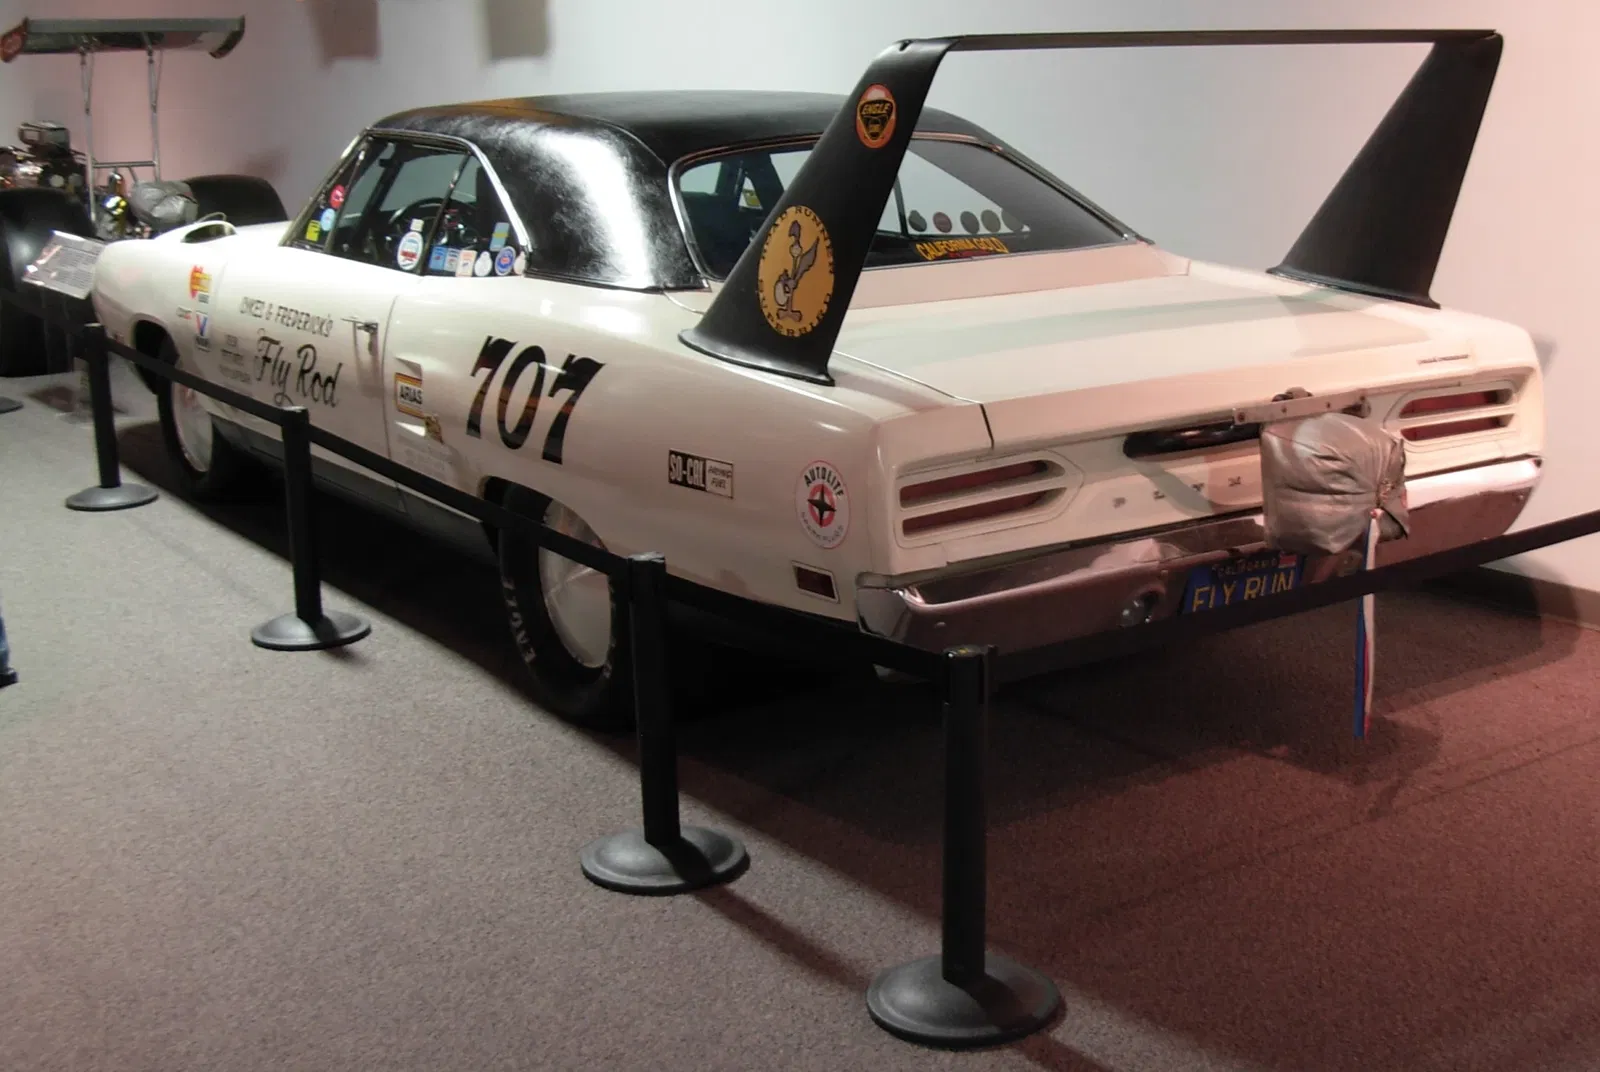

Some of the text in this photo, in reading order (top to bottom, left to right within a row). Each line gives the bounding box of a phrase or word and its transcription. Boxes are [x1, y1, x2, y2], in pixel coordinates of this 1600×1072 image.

[795, 205, 835, 274] RUNNER
[254, 327, 343, 408] Fly Rod
[466, 335, 607, 465] 707
[669, 453, 706, 488] SO-CAL
[803, 466, 844, 498] AUTOLITE
